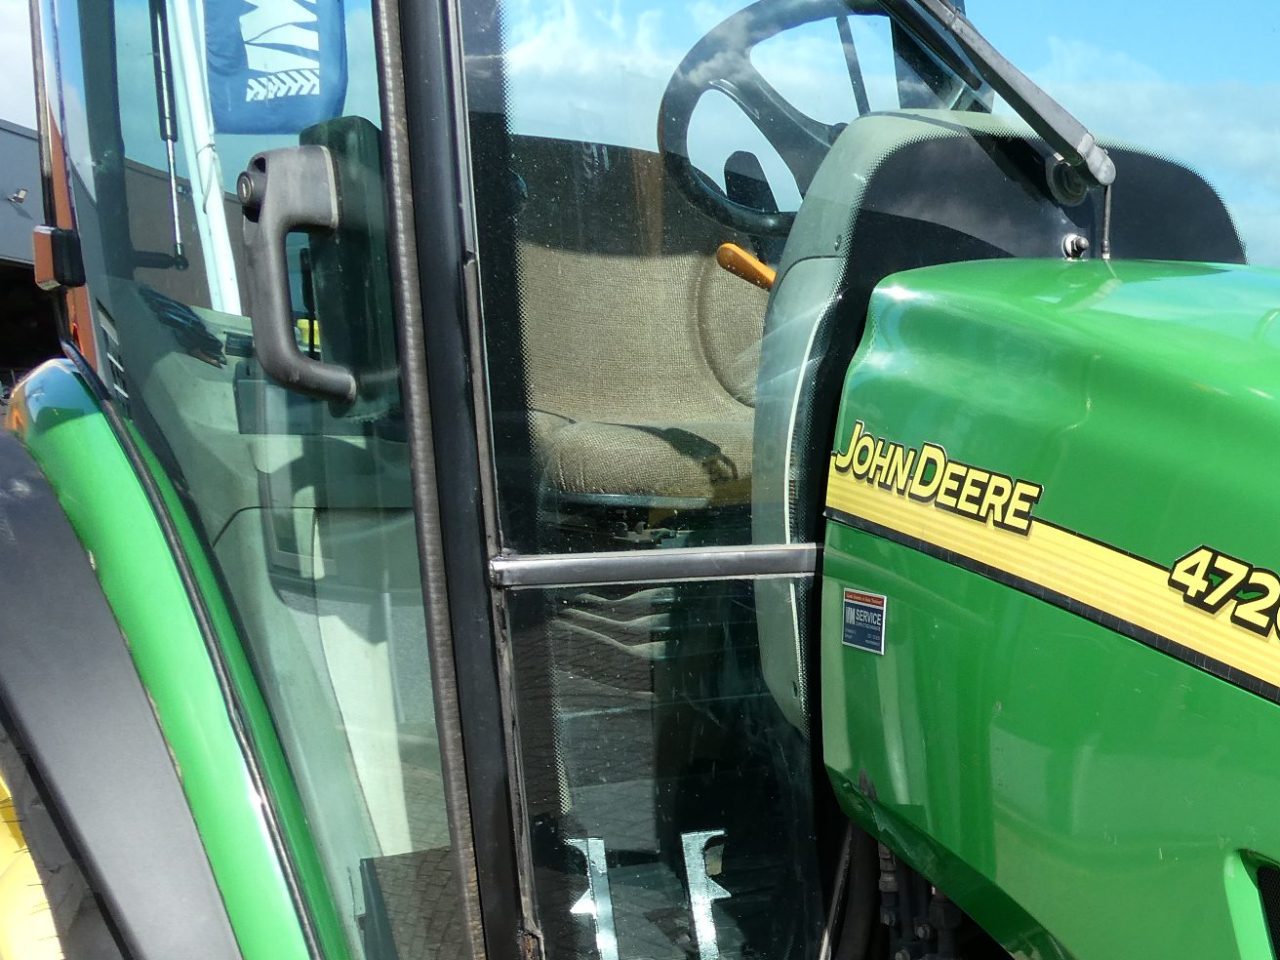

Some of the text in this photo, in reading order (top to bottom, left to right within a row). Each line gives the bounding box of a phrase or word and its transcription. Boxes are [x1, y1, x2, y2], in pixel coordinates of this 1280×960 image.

[834, 422, 1041, 534] JOHN DEERE
[855, 609, 882, 626] SERVICE
